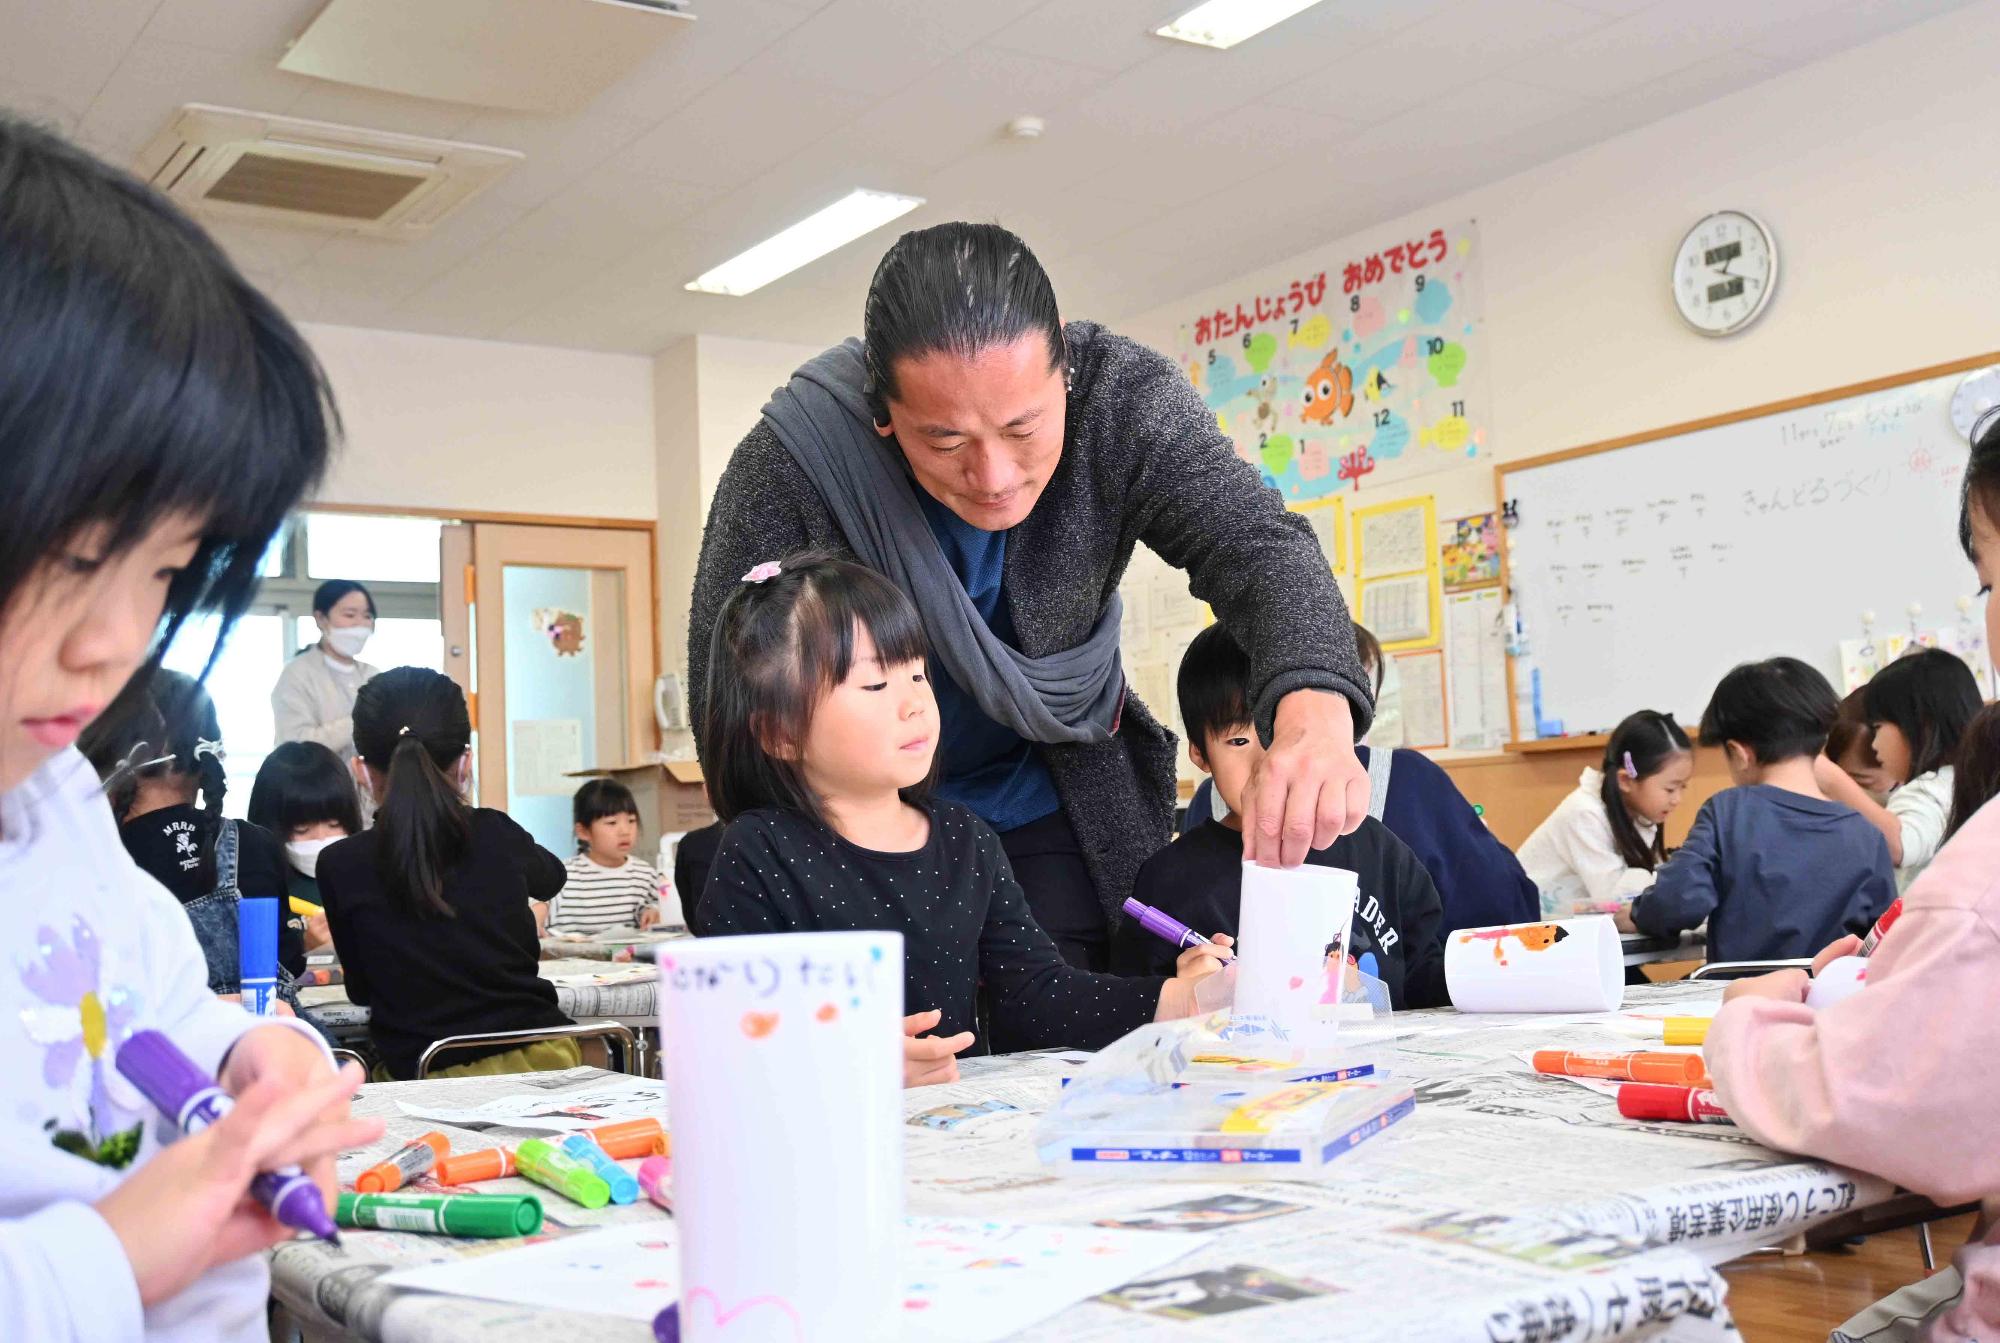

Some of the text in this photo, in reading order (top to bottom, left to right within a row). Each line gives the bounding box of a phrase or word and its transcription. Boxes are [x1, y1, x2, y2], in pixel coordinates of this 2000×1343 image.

[1195, 229, 1447, 346] おたんじょうび おめでとう
[1415, 274, 1425, 292] 9
[1350, 294, 1360, 312] 8
[1290, 318, 1299, 335] 7
[1242, 332, 1252, 349] 6
[1426, 336, 1445, 356] 10
[1208, 348, 1217, 366] 5
[1373, 408, 1391, 428] 12
[1451, 400, 1465, 418] 11
[1259, 432, 1269, 449] 2
[1299, 438, 1306, 455] 1
